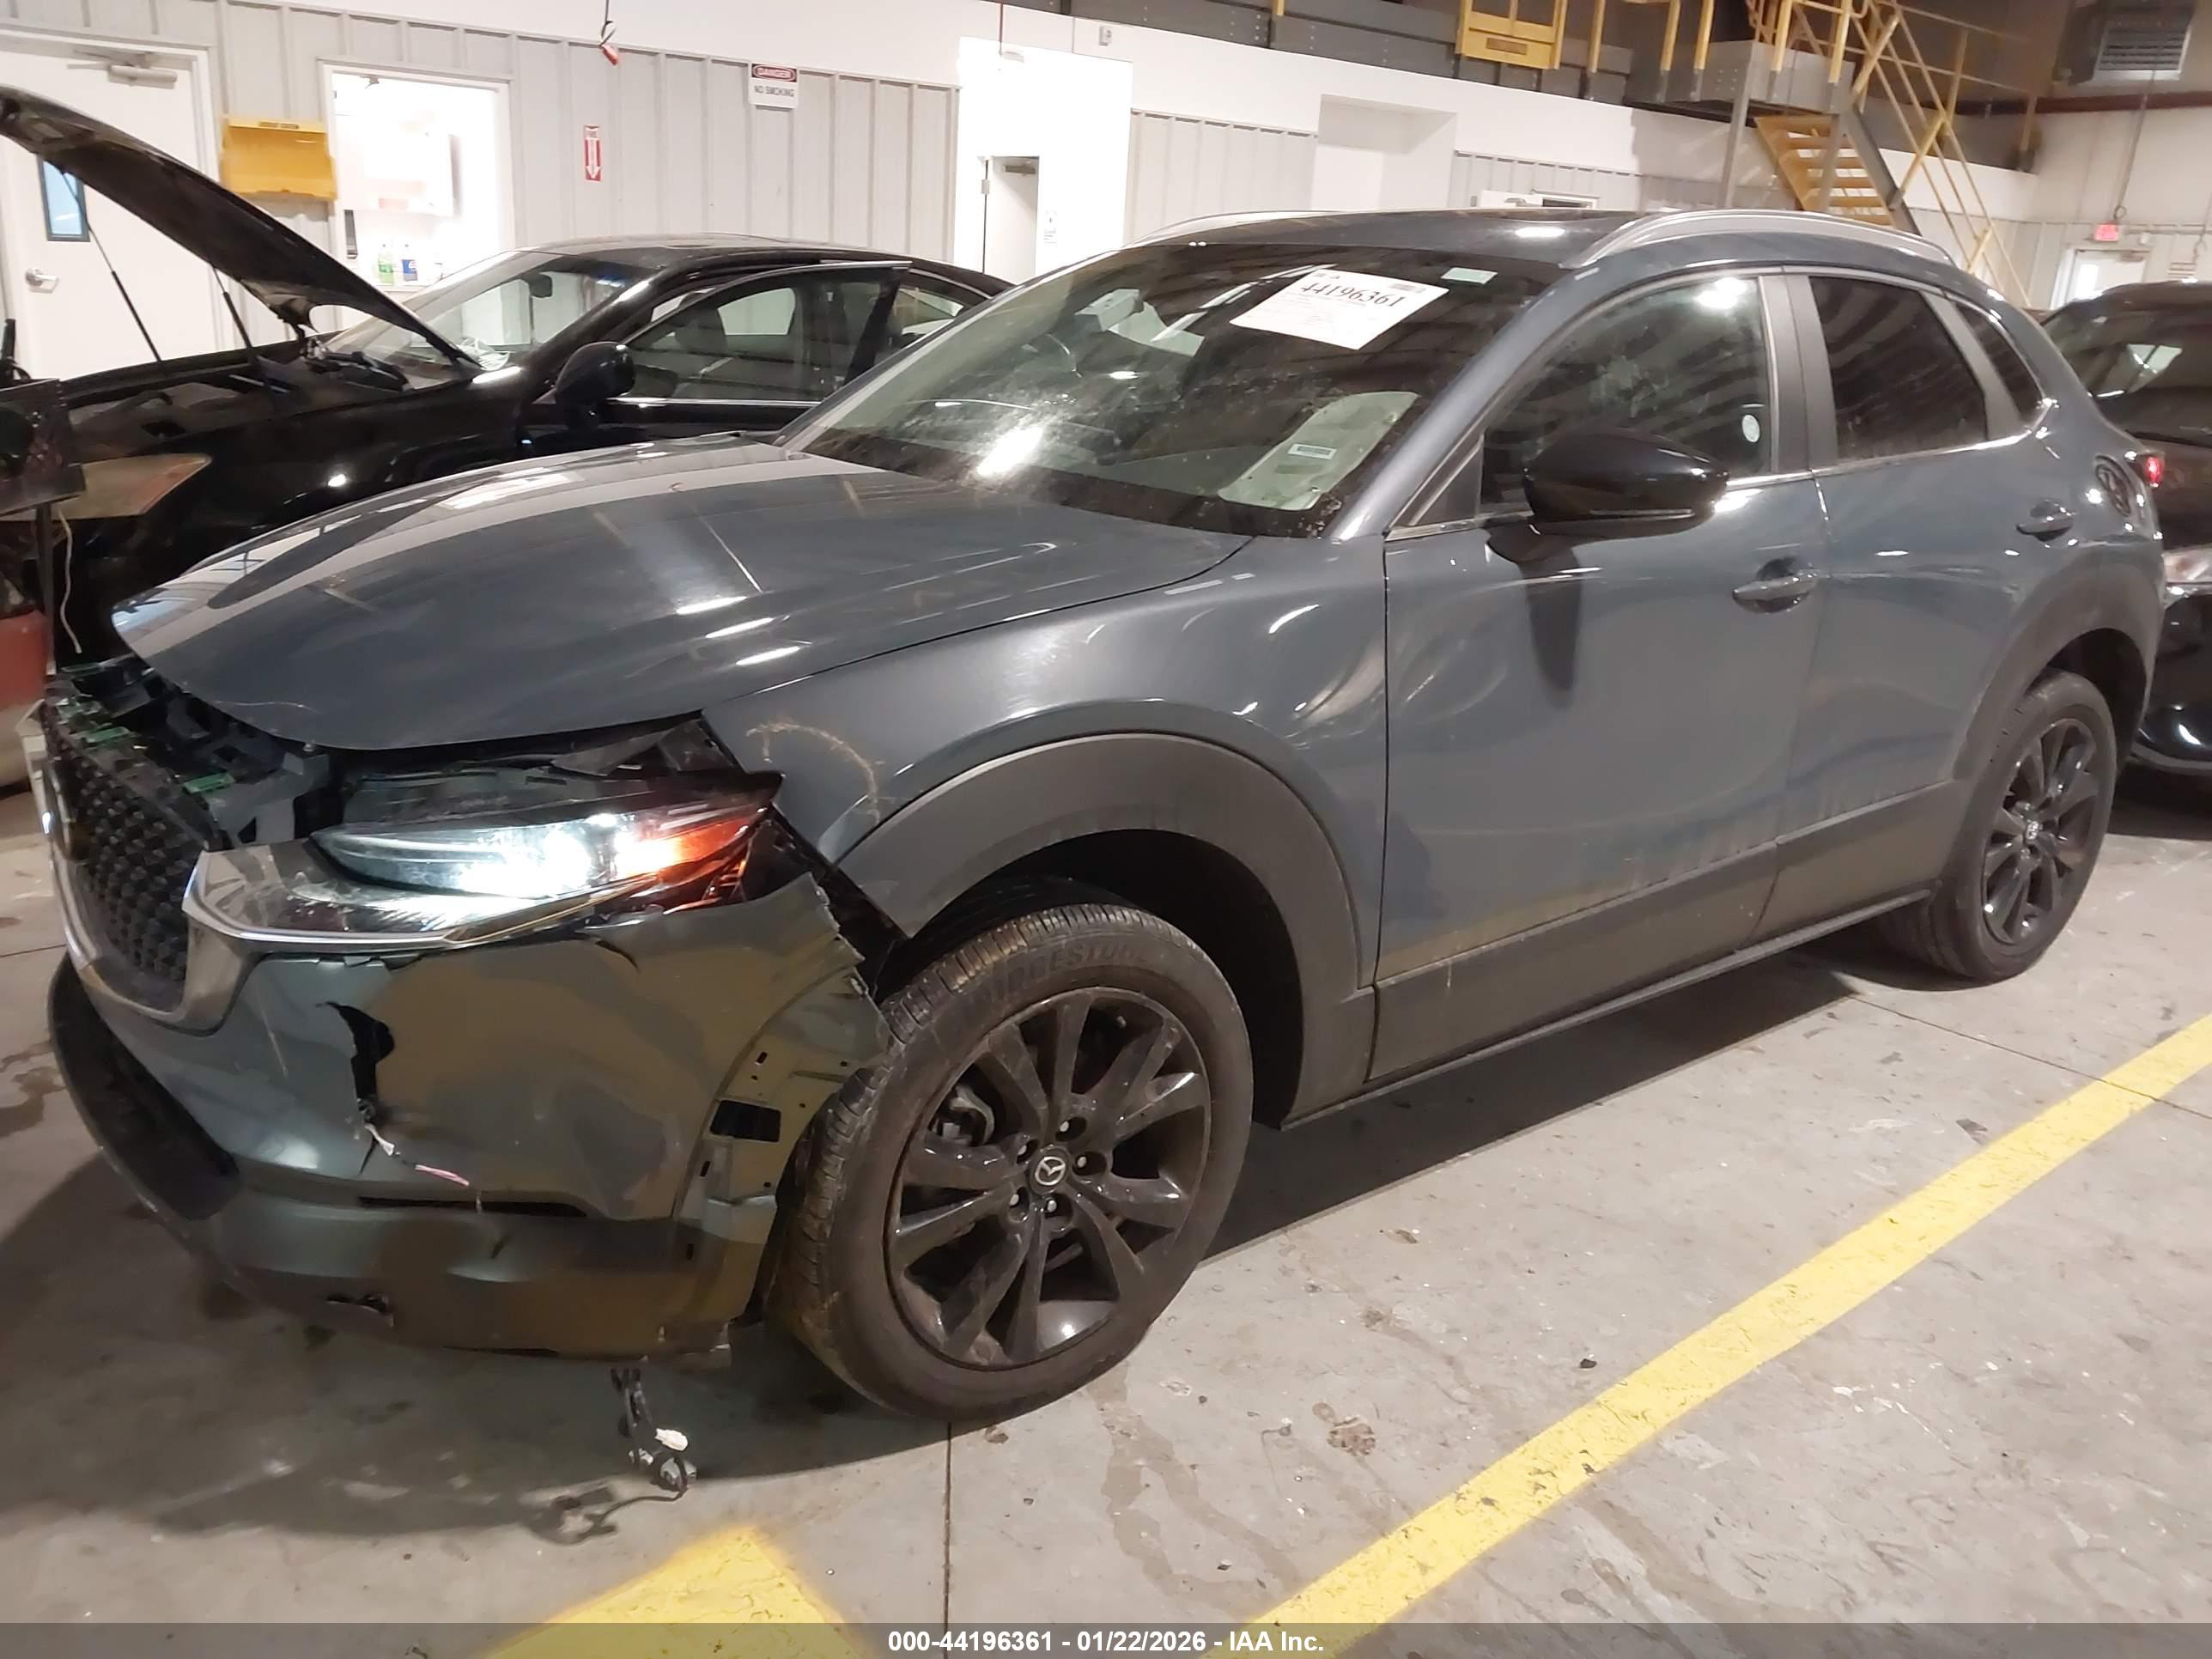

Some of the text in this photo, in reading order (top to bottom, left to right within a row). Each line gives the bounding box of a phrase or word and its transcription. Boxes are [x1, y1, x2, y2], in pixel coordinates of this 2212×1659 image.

[755, 85, 795, 97] NO SMOKING
[1299, 282, 1409, 307] 44196361
